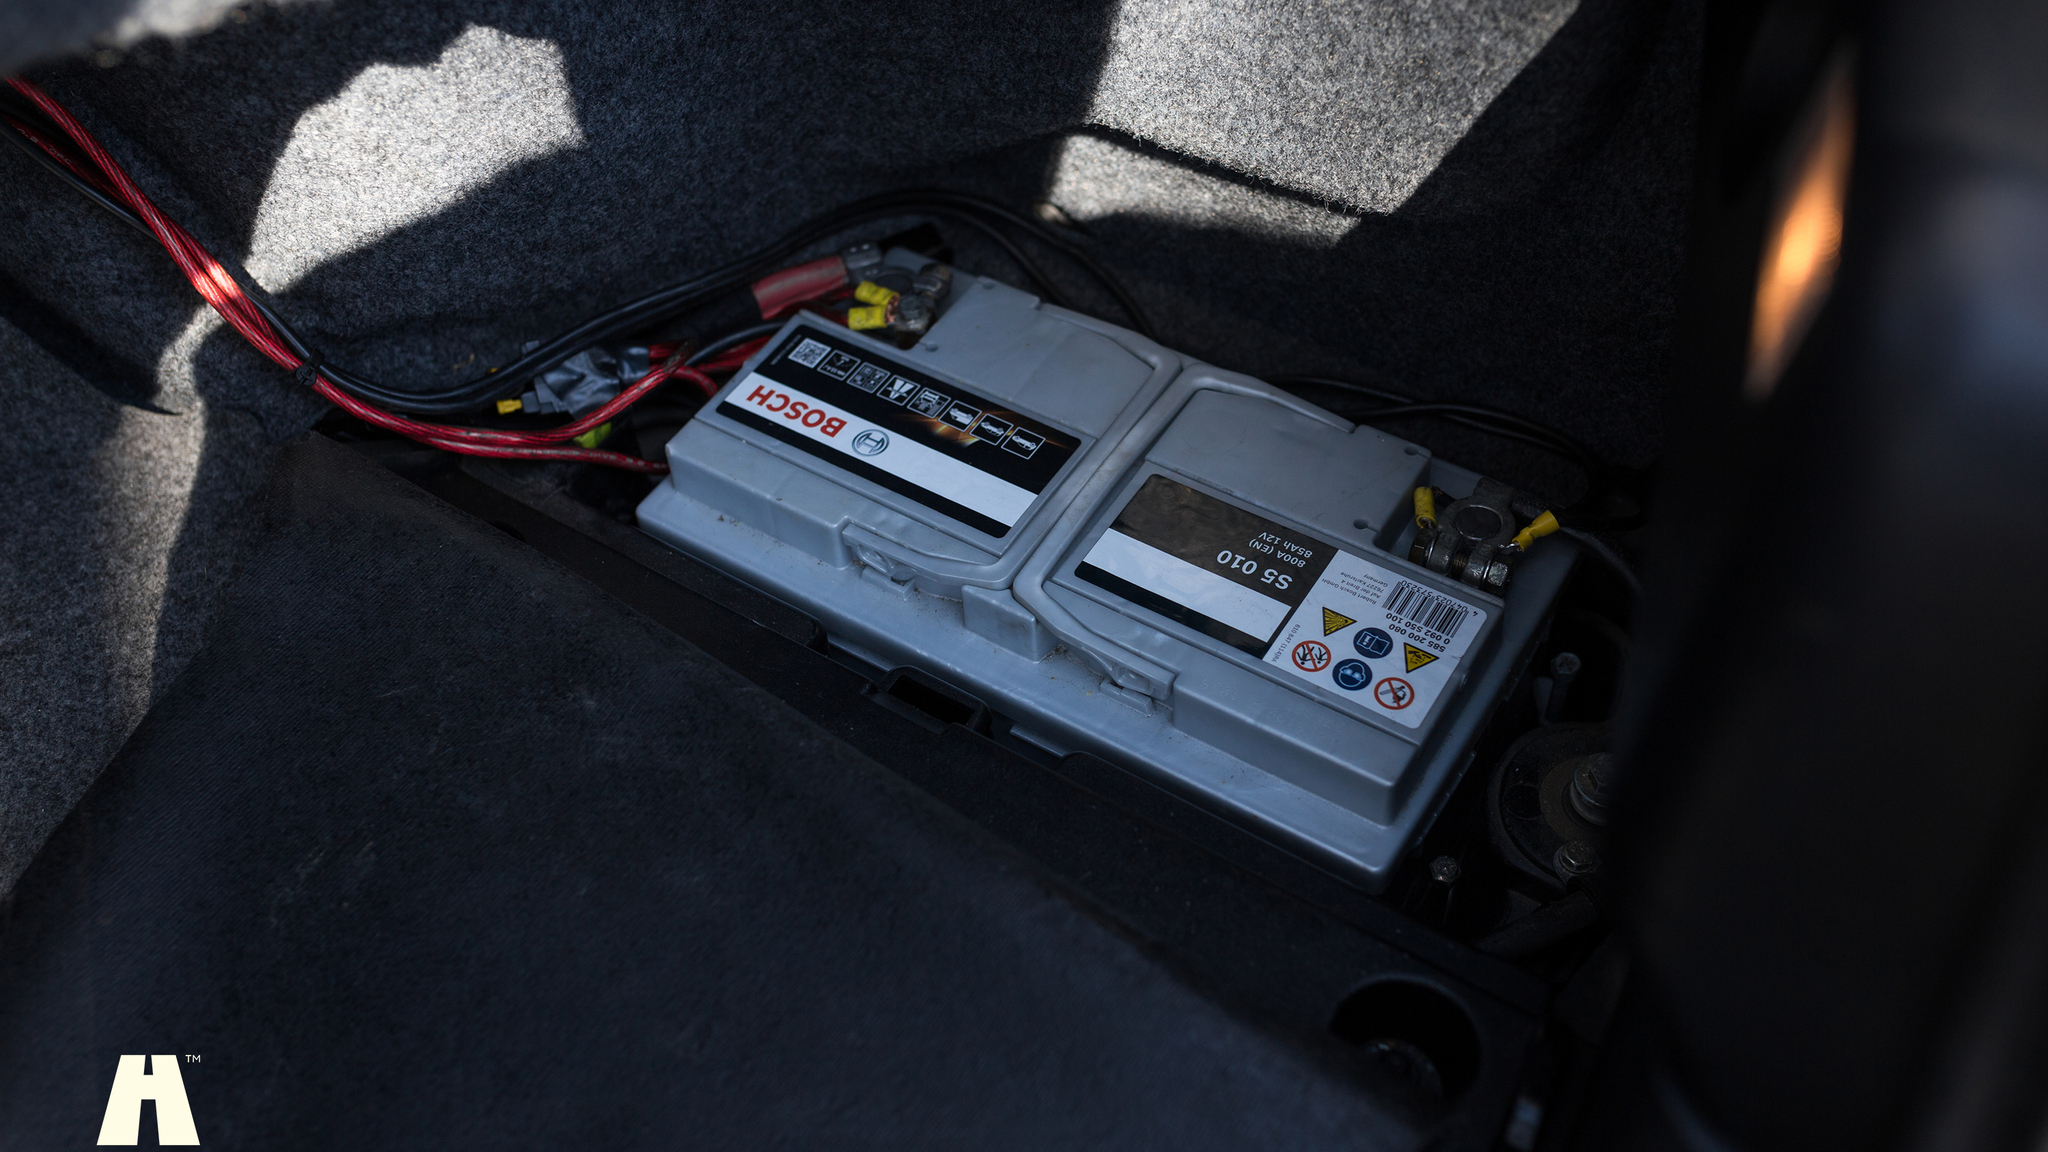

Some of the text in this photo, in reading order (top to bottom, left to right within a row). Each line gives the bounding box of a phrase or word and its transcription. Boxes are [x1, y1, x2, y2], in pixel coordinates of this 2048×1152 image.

[746, 385, 848, 438] BOSCH
[1248, 538, 1306, 568] 800A (EN)
[1258, 532, 1313, 558] 85Ah 12V
[1216, 550, 1293, 590] S5 010
[1340, 571, 1367, 586] Karlsruhe
[1363, 573, 1389, 588] Germany
[1399, 579, 1433, 598] 573230
[1321, 578, 1377, 605] Robert Bosch GmbH
[1435, 594, 1468, 613] 047023
[1385, 612, 1404, 624] 100
[1404, 621, 1424, 633] S50
[1388, 623, 1446, 653] 585 200 080
[1424, 629, 1443, 641] 092
